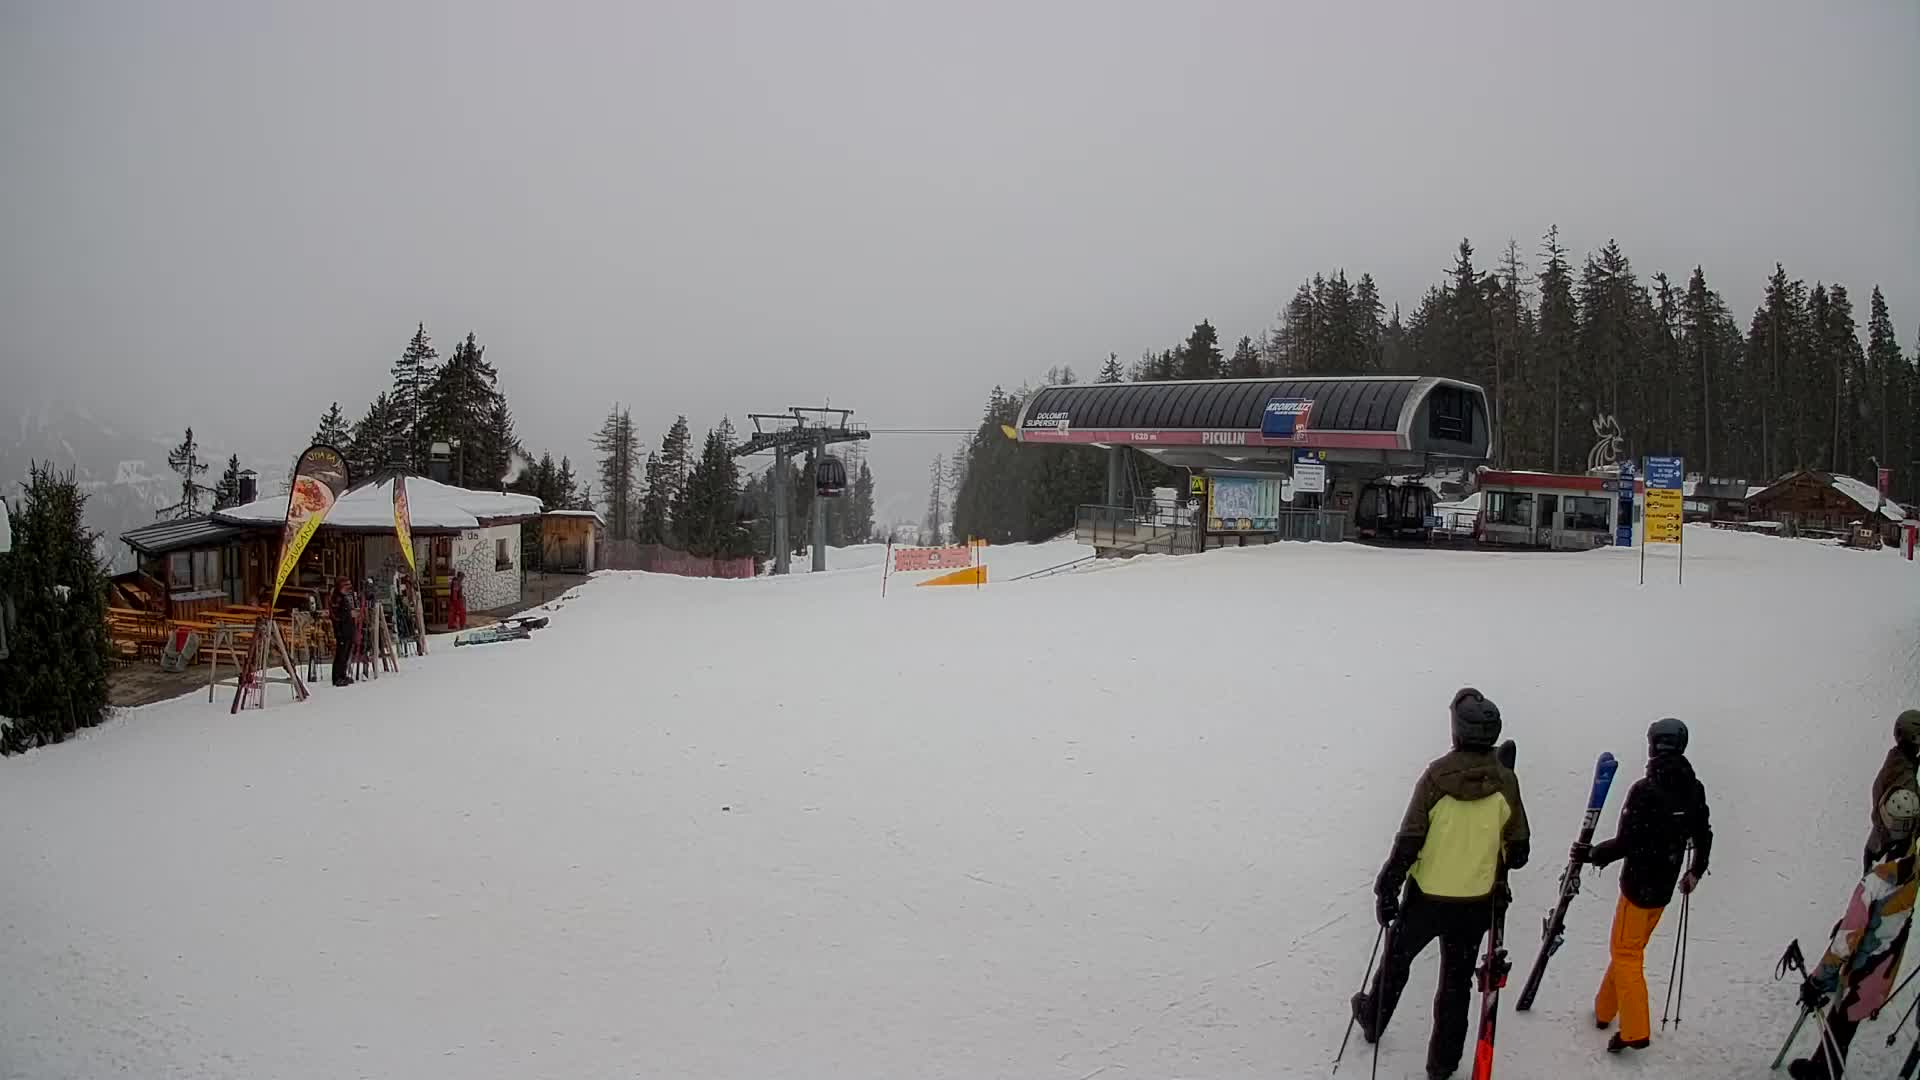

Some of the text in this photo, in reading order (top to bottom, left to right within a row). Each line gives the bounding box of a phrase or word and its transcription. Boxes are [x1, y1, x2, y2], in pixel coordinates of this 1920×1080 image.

[1266, 402, 1312, 411] KRONPLATZ
[1037, 412, 1068, 420] DOLOMITI
[1026, 419, 1059, 427] SUPERSKI
[1131, 432, 1148, 440] 1620
[1202, 432, 1246, 444] PICULIN
[277, 520, 316, 587] RESTAURANT
